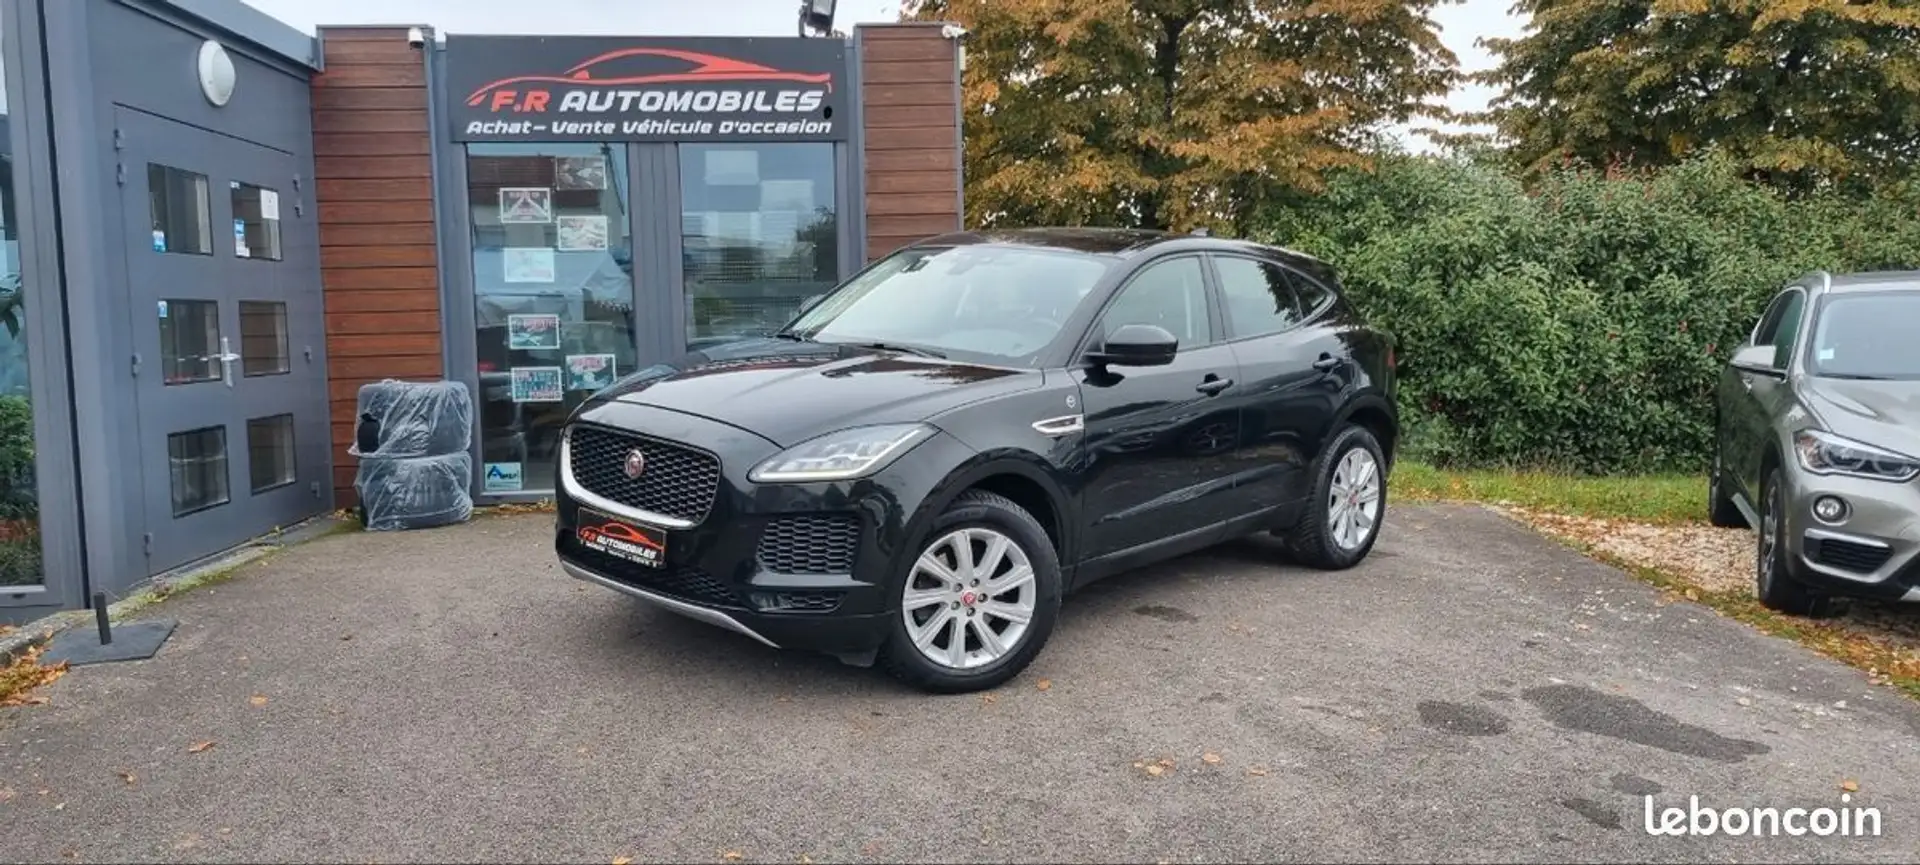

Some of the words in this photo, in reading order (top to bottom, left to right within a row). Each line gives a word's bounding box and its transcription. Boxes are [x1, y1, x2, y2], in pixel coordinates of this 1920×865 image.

[491, 90, 550, 113] F.R
[559, 90, 824, 113] AUTOMOBILES
[552, 120, 616, 135] Vente
[623, 118, 713, 135] Véhicule
[719, 119, 832, 135] D'occasion
[597, 535, 657, 559] AUTOMOBILES
